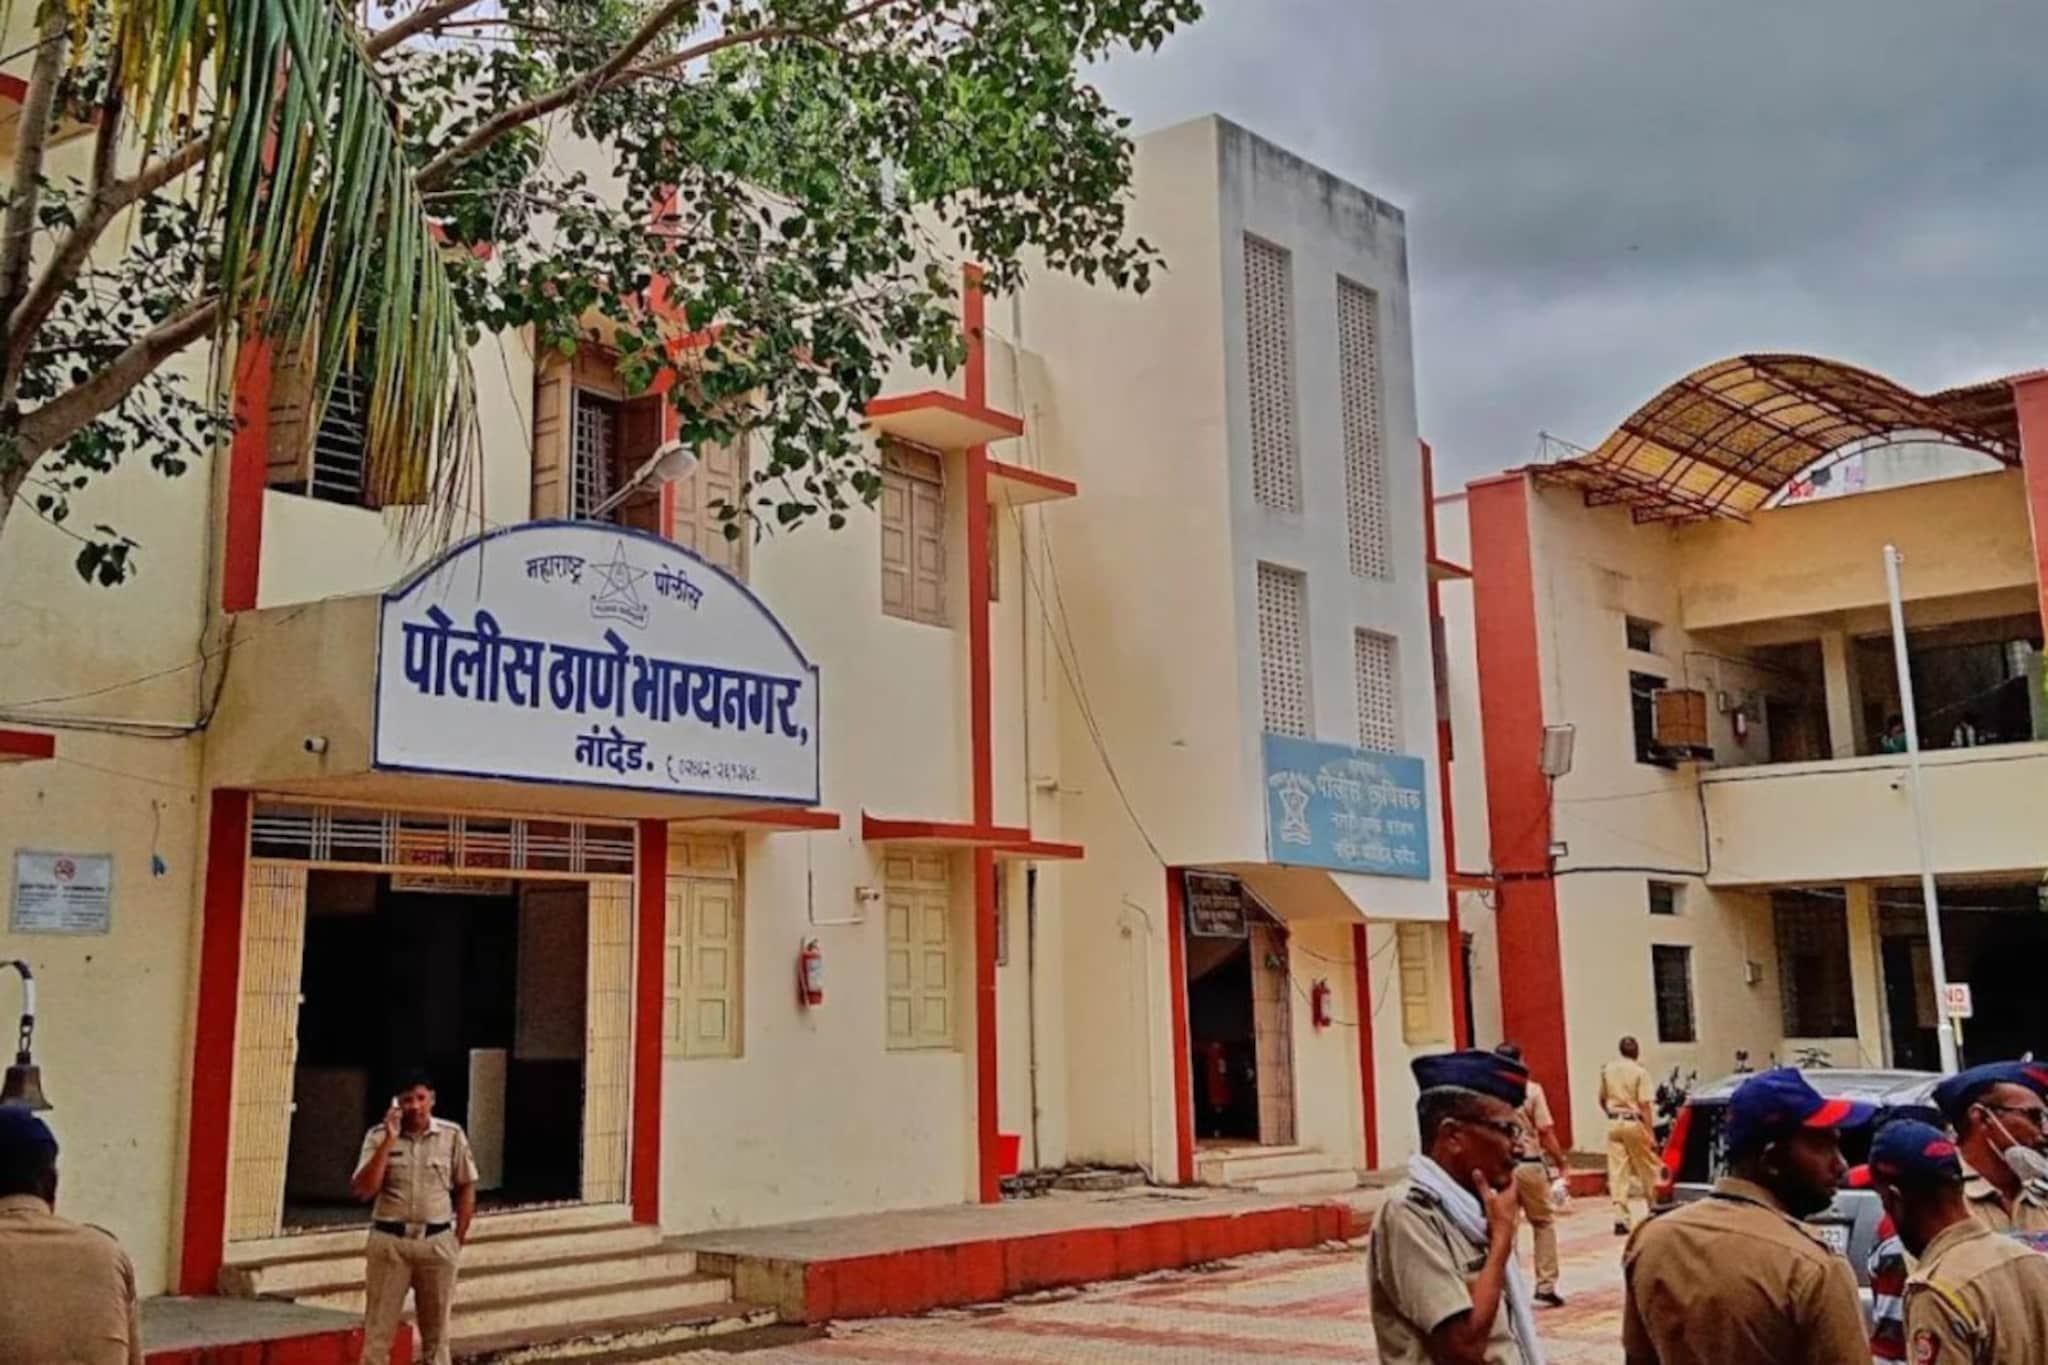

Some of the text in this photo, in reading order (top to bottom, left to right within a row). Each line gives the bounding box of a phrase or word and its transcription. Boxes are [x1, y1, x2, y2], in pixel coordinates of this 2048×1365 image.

[525, 555, 704, 611] महाराष्ट्र पोलीस
[402, 604, 808, 746] पोलीस ठाणे भाग्यनगर,
[575, 725, 654, 774] नांदेड.
